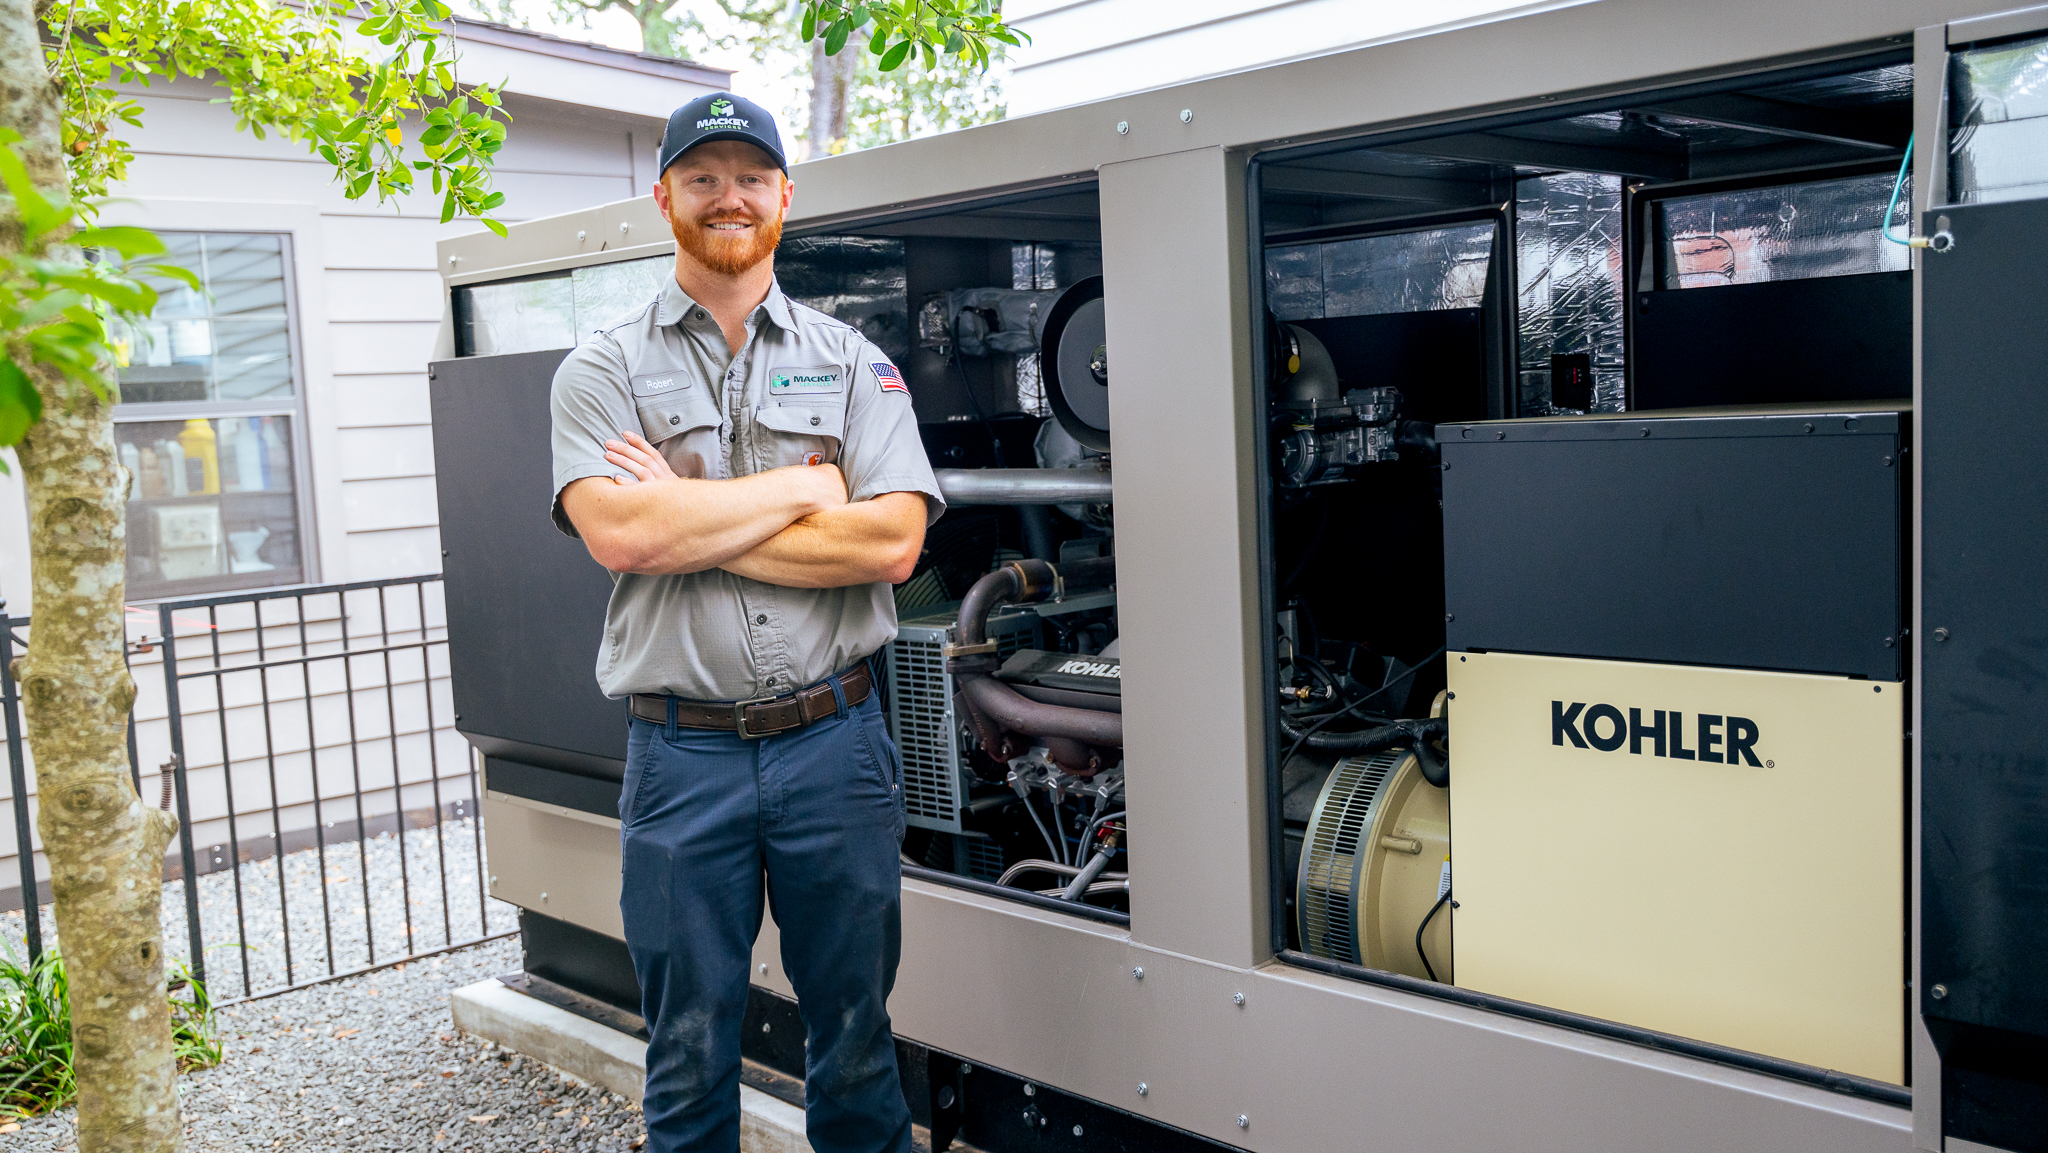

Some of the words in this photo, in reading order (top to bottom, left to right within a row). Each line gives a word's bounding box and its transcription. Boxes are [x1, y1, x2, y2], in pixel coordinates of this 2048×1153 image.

[697, 118, 749, 129] MACKEY
[793, 374, 838, 382] MACKEY
[646, 378, 674, 390] Robert
[1551, 700, 1765, 769] KOHLER
